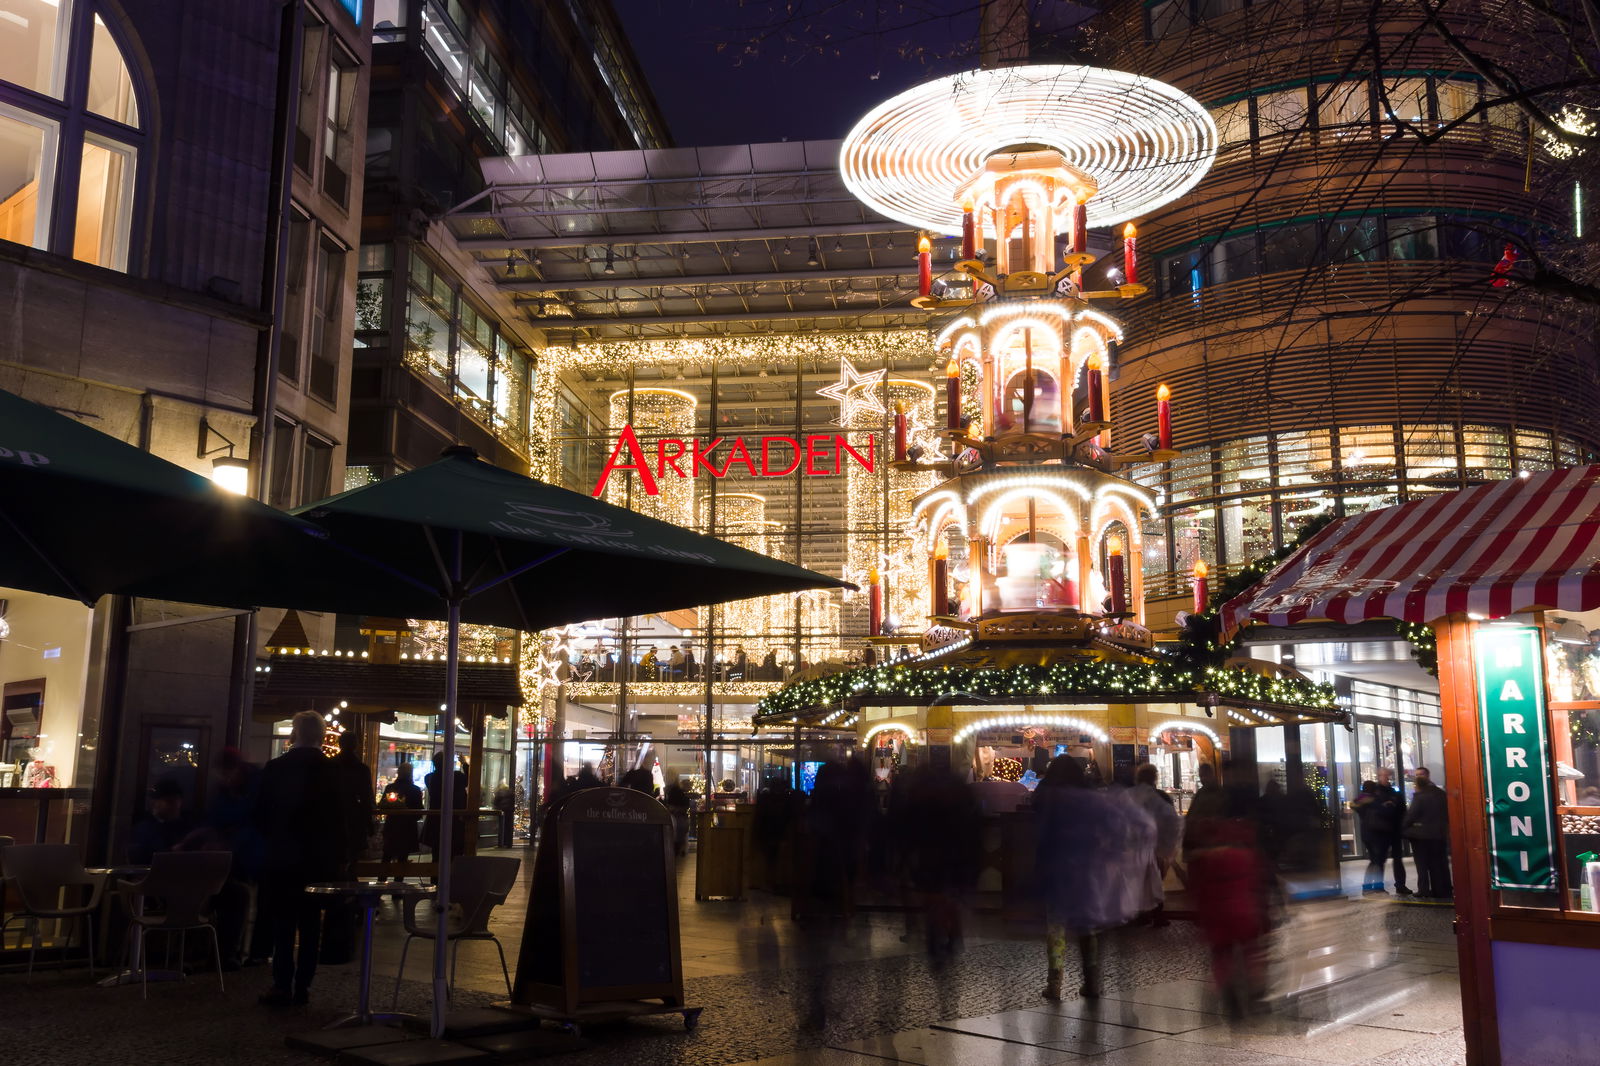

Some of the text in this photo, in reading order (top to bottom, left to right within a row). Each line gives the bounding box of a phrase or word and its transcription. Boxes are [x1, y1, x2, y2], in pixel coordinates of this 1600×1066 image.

[591, 424, 875, 497] ARKADEN
[489, 520, 546, 538] the
[1496, 645, 1533, 872] MARRONI
[586, 807, 648, 823] the coffee shop
